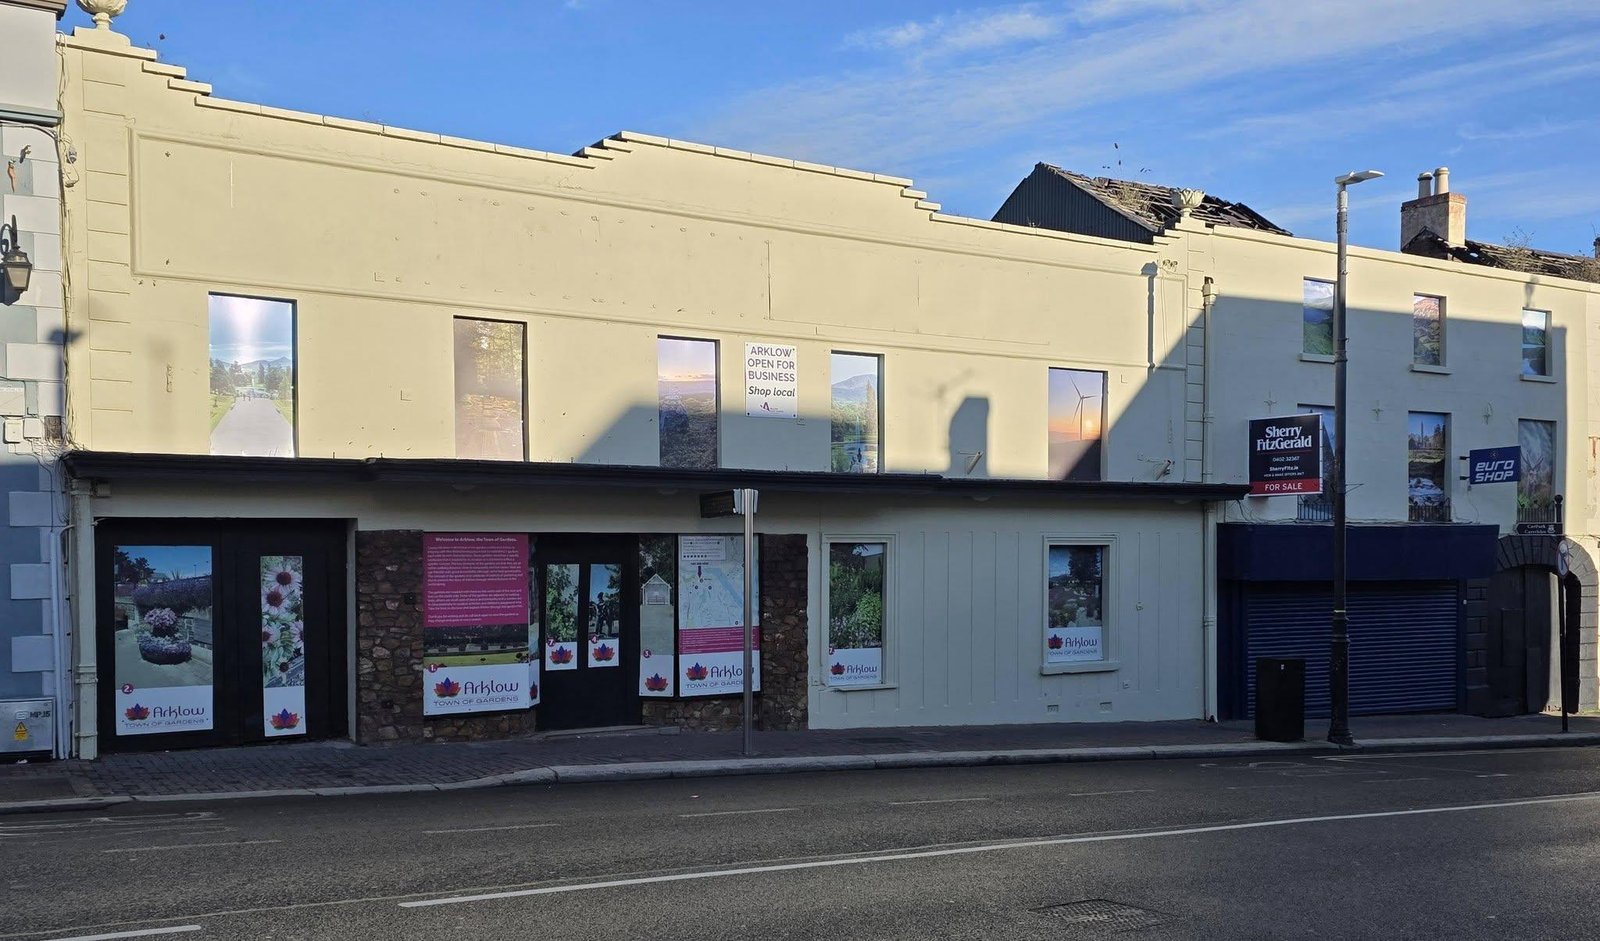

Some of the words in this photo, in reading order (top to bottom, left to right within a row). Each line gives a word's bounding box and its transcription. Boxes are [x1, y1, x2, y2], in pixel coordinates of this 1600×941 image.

[751, 347, 791, 357] ARKLOW
[748, 359, 773, 368] OPEN
[777, 361, 794, 369] FOR
[749, 371, 794, 382] BUSINESS
[749, 386, 771, 397] Shop
[774, 387, 795, 397] local
[1265, 426, 1302, 438] Sherry
[1257, 436, 1312, 451] FitzGerald
[1475, 460, 1514, 472] euro
[1475, 471, 1514, 481] SHOP
[1065, 637, 1098, 649] Arklow
[710, 665, 755, 679] Arklo
[846, 665, 878, 674] Arklow
[464, 680, 519, 696] Arklow
[433, 698, 460, 707] TOWN
[476, 695, 519, 704] GARDENS
[153, 705, 205, 719] Arklow
[165, 718, 205, 727] GARDENS
